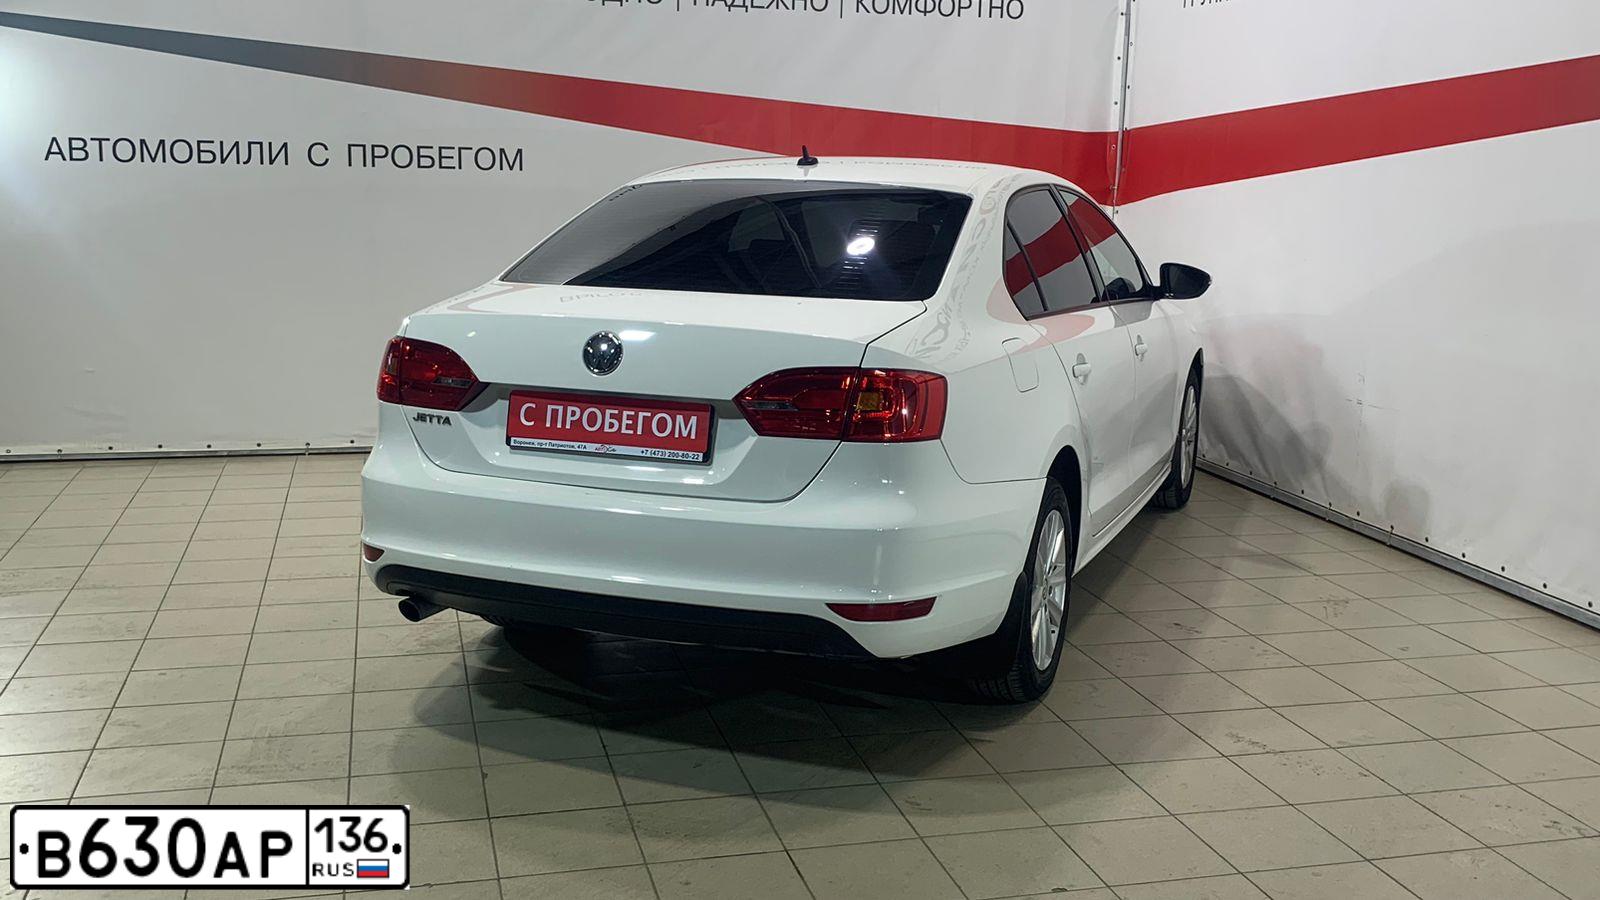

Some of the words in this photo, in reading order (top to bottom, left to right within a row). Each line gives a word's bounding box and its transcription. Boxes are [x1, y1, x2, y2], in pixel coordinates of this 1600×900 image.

[855, 0, 1025, 20] КОМФОРТНО
[44, 136, 290, 165] АВТОМОБИЛИ
[306, 142, 330, 167] С
[347, 143, 524, 171] ПРОБЕГОМ
[412, 411, 452, 426] JETTA
[519, 402, 536, 426] С
[545, 404, 698, 440] ПРОБЕГОМ
[650, 450, 667, 459] (473)
